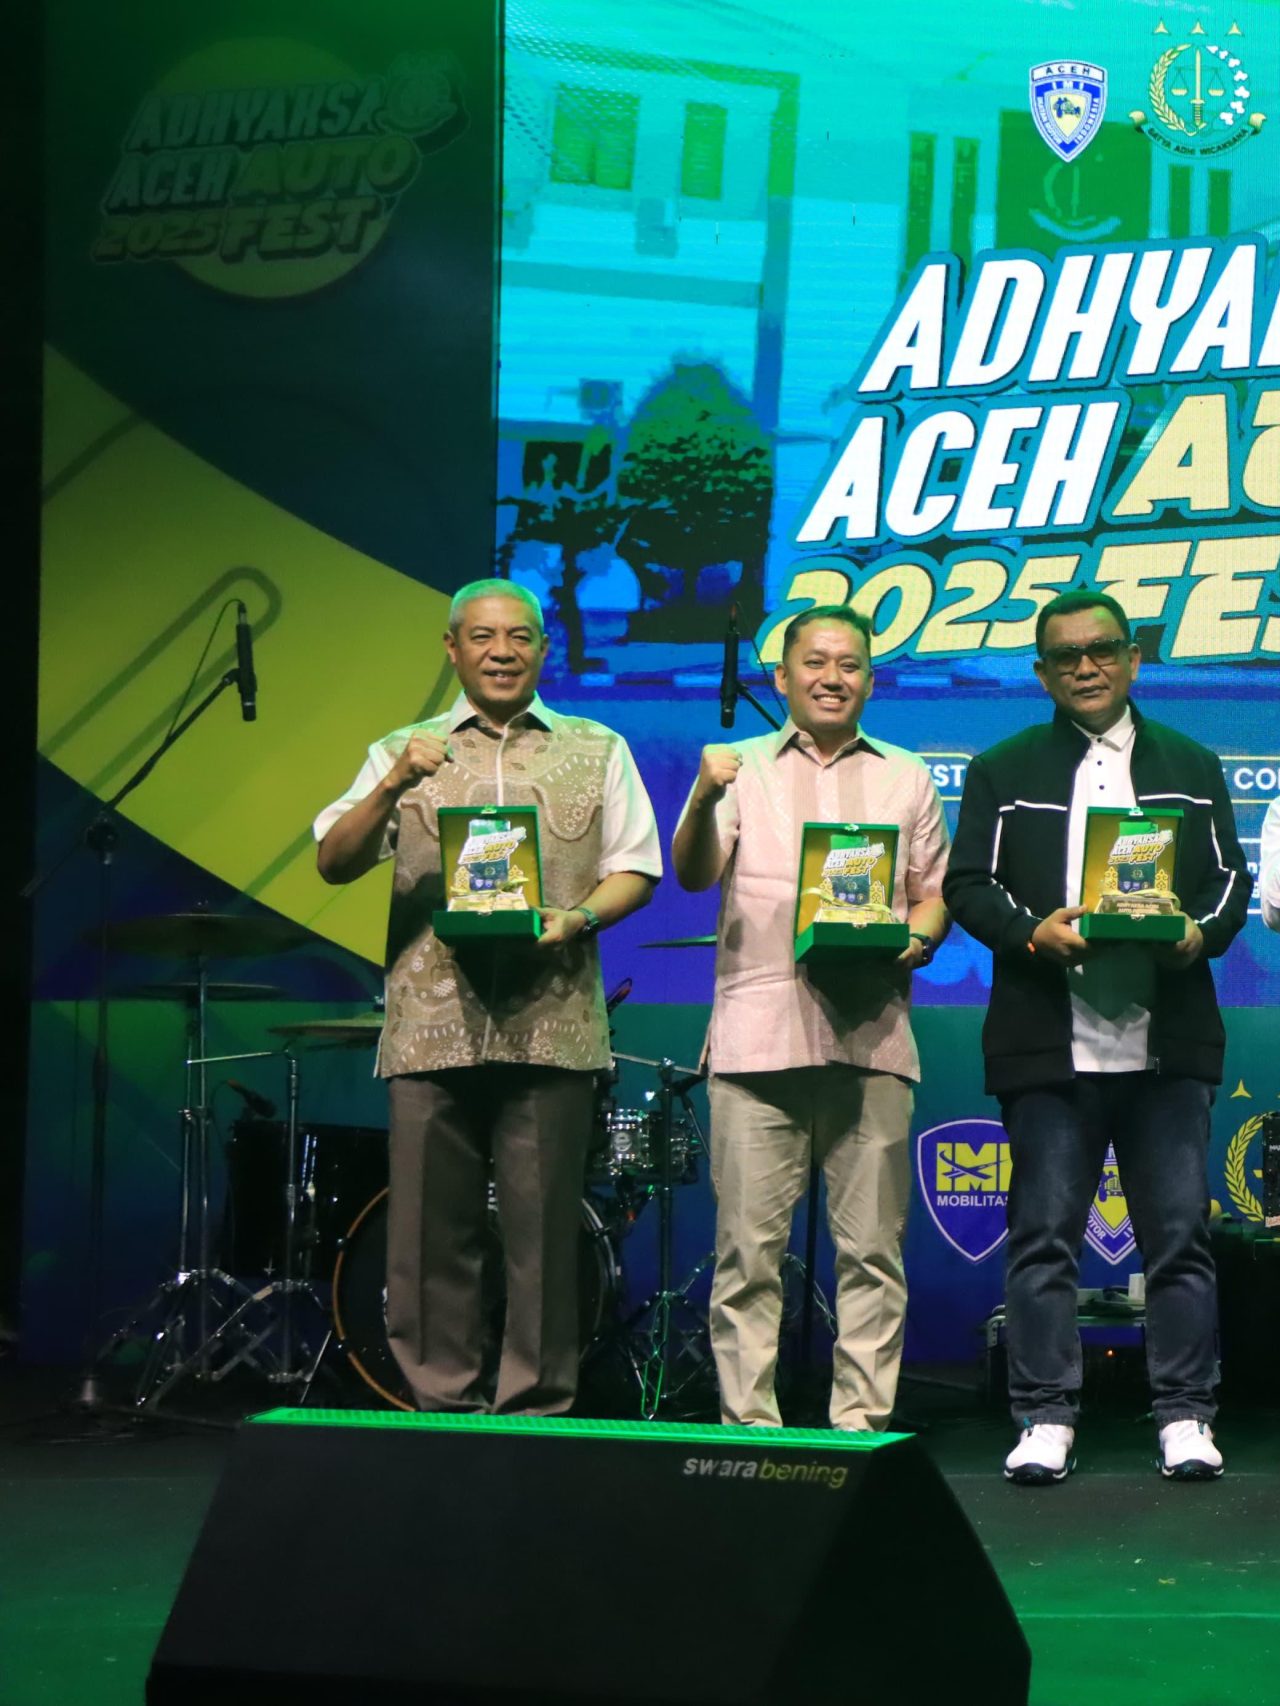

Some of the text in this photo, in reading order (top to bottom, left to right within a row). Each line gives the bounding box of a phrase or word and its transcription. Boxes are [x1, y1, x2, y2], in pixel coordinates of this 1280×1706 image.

[1045, 65, 1091, 75] ACEH
[126, 80, 384, 151] ADHYAKSA
[107, 134, 414, 210] ACEH AUTO
[94, 198, 378, 261] 2025 FEST
[796, 401, 1120, 542] ACEH
[757, 554, 1082, 664] 2025
[926, 764, 967, 787] ST
[683, 1458, 848, 1488] swarabening
